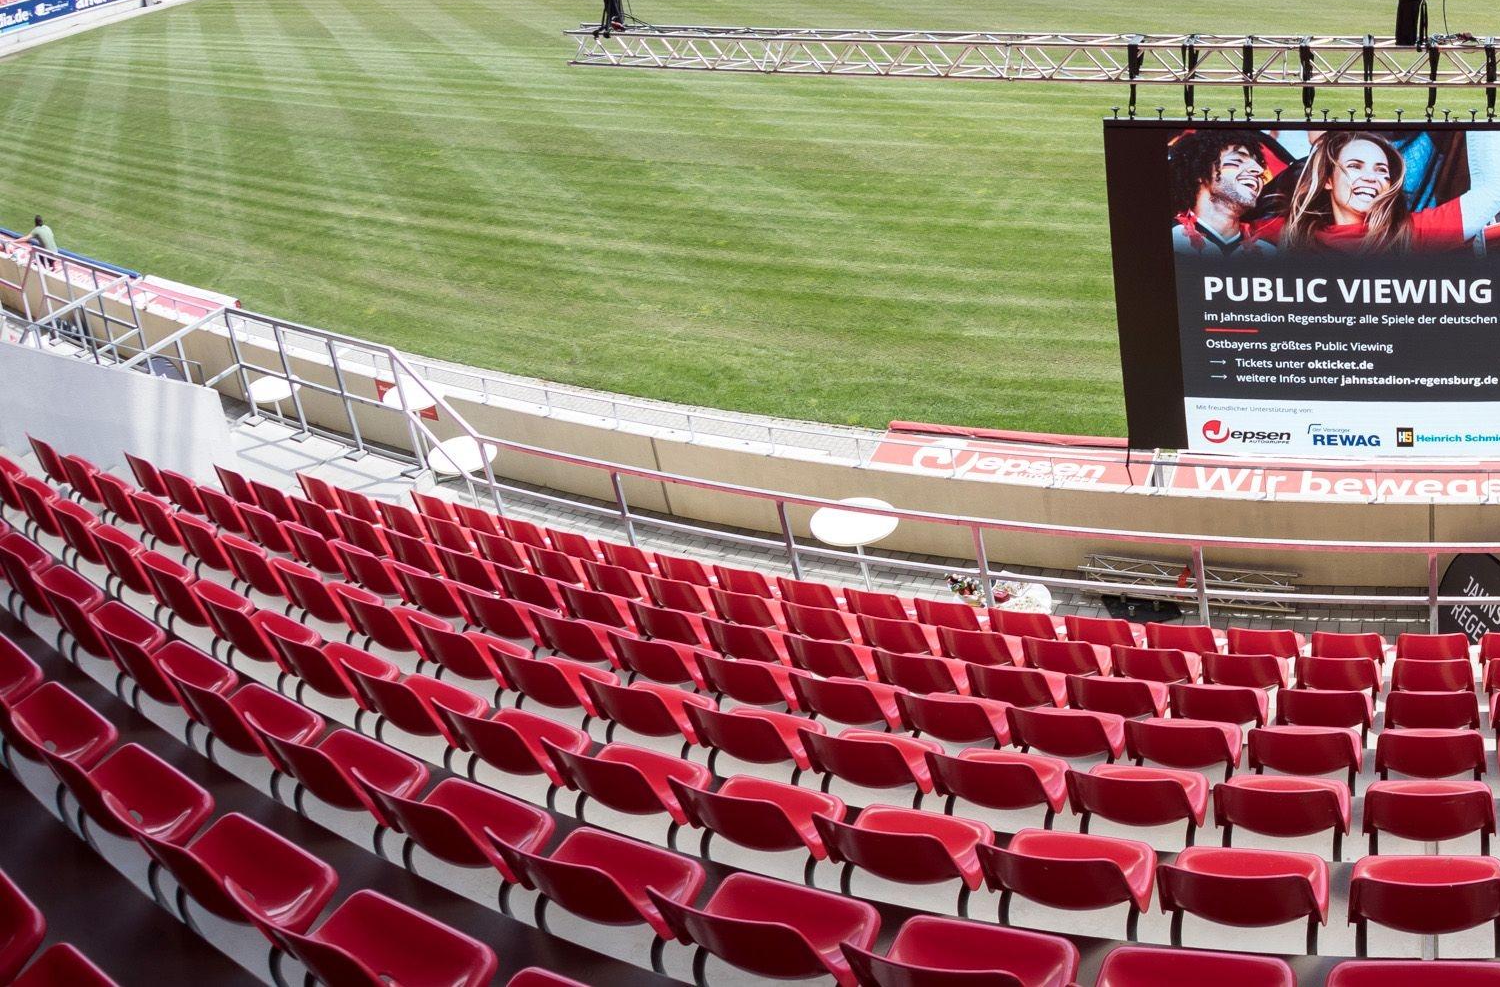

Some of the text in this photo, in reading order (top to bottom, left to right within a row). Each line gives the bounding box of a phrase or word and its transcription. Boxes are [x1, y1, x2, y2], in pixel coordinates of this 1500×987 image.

[1204, 276, 1492, 305] PUBLIC VIEWING
[1204, 312, 1218, 322] im
[1220, 312, 1285, 323] Jahnstadion
[1287, 314, 1357, 326] Regensburg:
[1359, 314, 1379, 324] alle
[1381, 314, 1415, 326] Spiele
[1417, 314, 1437, 325] der
[1439, 314, 1498, 324] deutschen
[1206, 339, 1394, 354] Ostbayerns größtes Public Viewing
[1235, 357, 1374, 370] Tickets unter okticket.de
[1236, 373, 1498, 387] weitere Infos unter jahnstadion-regensburg.de
[1208, 404, 1248, 412] freundlicher
[1250, 406, 1298, 414] Unterstützung
[1202, 419, 1291, 444] Jepsen
[1397, 430, 1413, 443] HS
[1416, 434, 1462, 443] Heinrich
[1313, 434, 1381, 447] REWAG
[912, 438, 1105, 476] Jepsen
[1195, 466, 1287, 493] Wir
